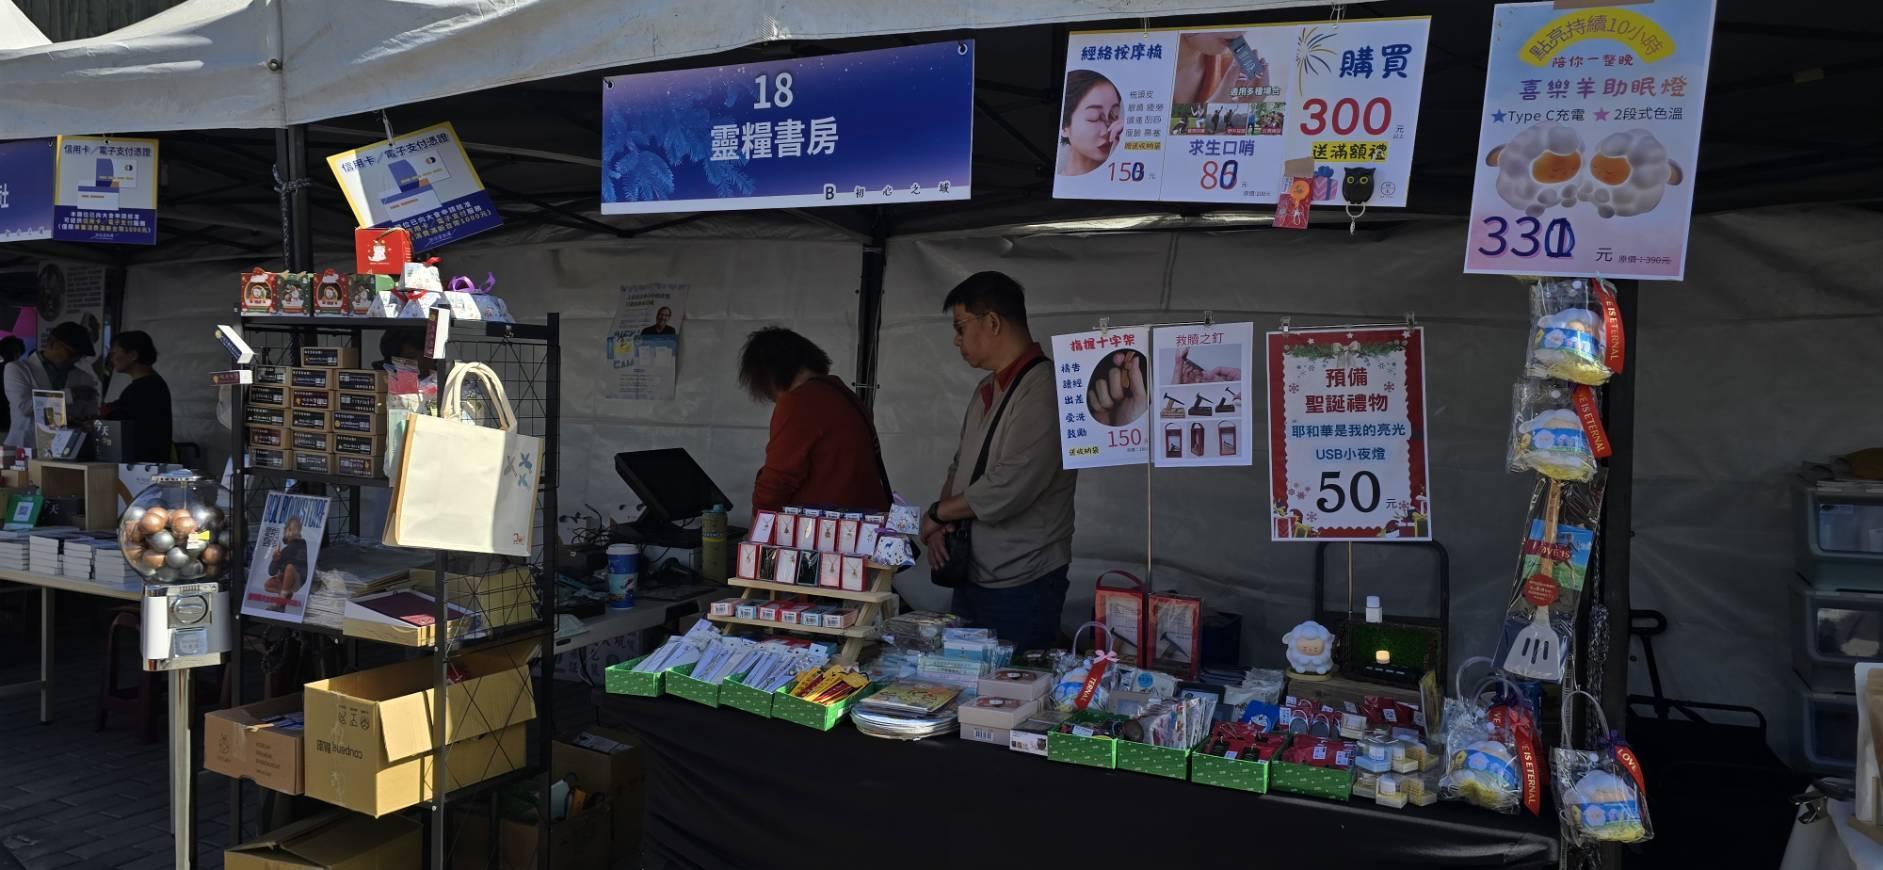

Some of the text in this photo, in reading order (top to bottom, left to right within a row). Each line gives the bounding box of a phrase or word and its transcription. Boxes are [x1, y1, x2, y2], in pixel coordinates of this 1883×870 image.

[1528, 15, 1664, 60] 點亮持續10小時
[1081, 43, 1162, 61] 經絡按摩梳
[1339, 44, 1412, 79] 購買
[1551, 54, 1634, 68] 陪你一整晚
[753, 72, 794, 109] 18
[1519, 76, 1688, 101] 喜樂羊助眠燈
[1299, 97, 1392, 136] 300
[1508, 108, 1585, 125] Type C充電
[1613, 107, 1683, 121] 2段式色溫
[710, 116, 839, 161] 靈糧書房
[1189, 139, 1255, 156] 求生口哨
[1312, 143, 1387, 160] 送滿額禮
[825, 186, 835, 200] B
[1595, 247, 1613, 262] 元
[1609, 317, 1620, 361] ETERNAL
[1325, 367, 1368, 388] 預備
[1064, 394, 1084, 405] 出差
[1305, 393, 1388, 414] 聖誕禮物
[1065, 412, 1086, 423] 受洗
[1108, 428, 1142, 448] 150
[1291, 423, 1406, 438] 耶和華是我的亮光
[1583, 413, 1606, 452] ETERNAL
[1316, 447, 1385, 461] USB小夜燈
[1316, 470, 1398, 513] 50 元
[1525, 762, 1536, 804] ETERNAL
